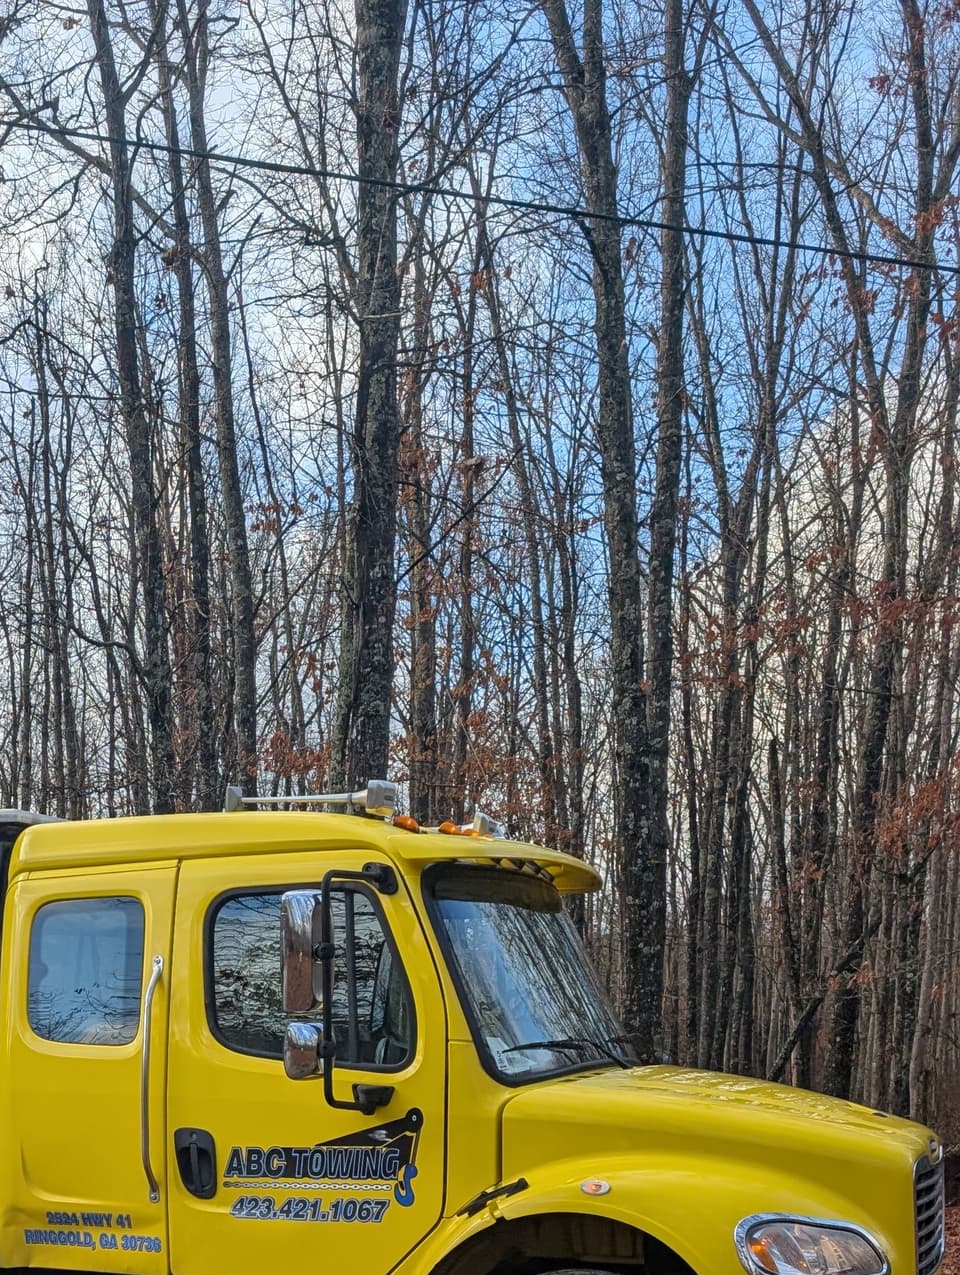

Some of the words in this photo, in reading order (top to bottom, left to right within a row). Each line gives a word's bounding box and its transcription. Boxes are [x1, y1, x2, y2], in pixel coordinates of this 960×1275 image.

[224, 1146, 287, 1178] ABC
[291, 1147, 401, 1180] TOWING
[81, 1212, 112, 1228] HWY
[116, 1213, 133, 1229] 41
[229, 1195, 391, 1223] 423.421.1067
[24, 1229, 97, 1251] RINGGOLD,
[99, 1233, 118, 1250] GA
